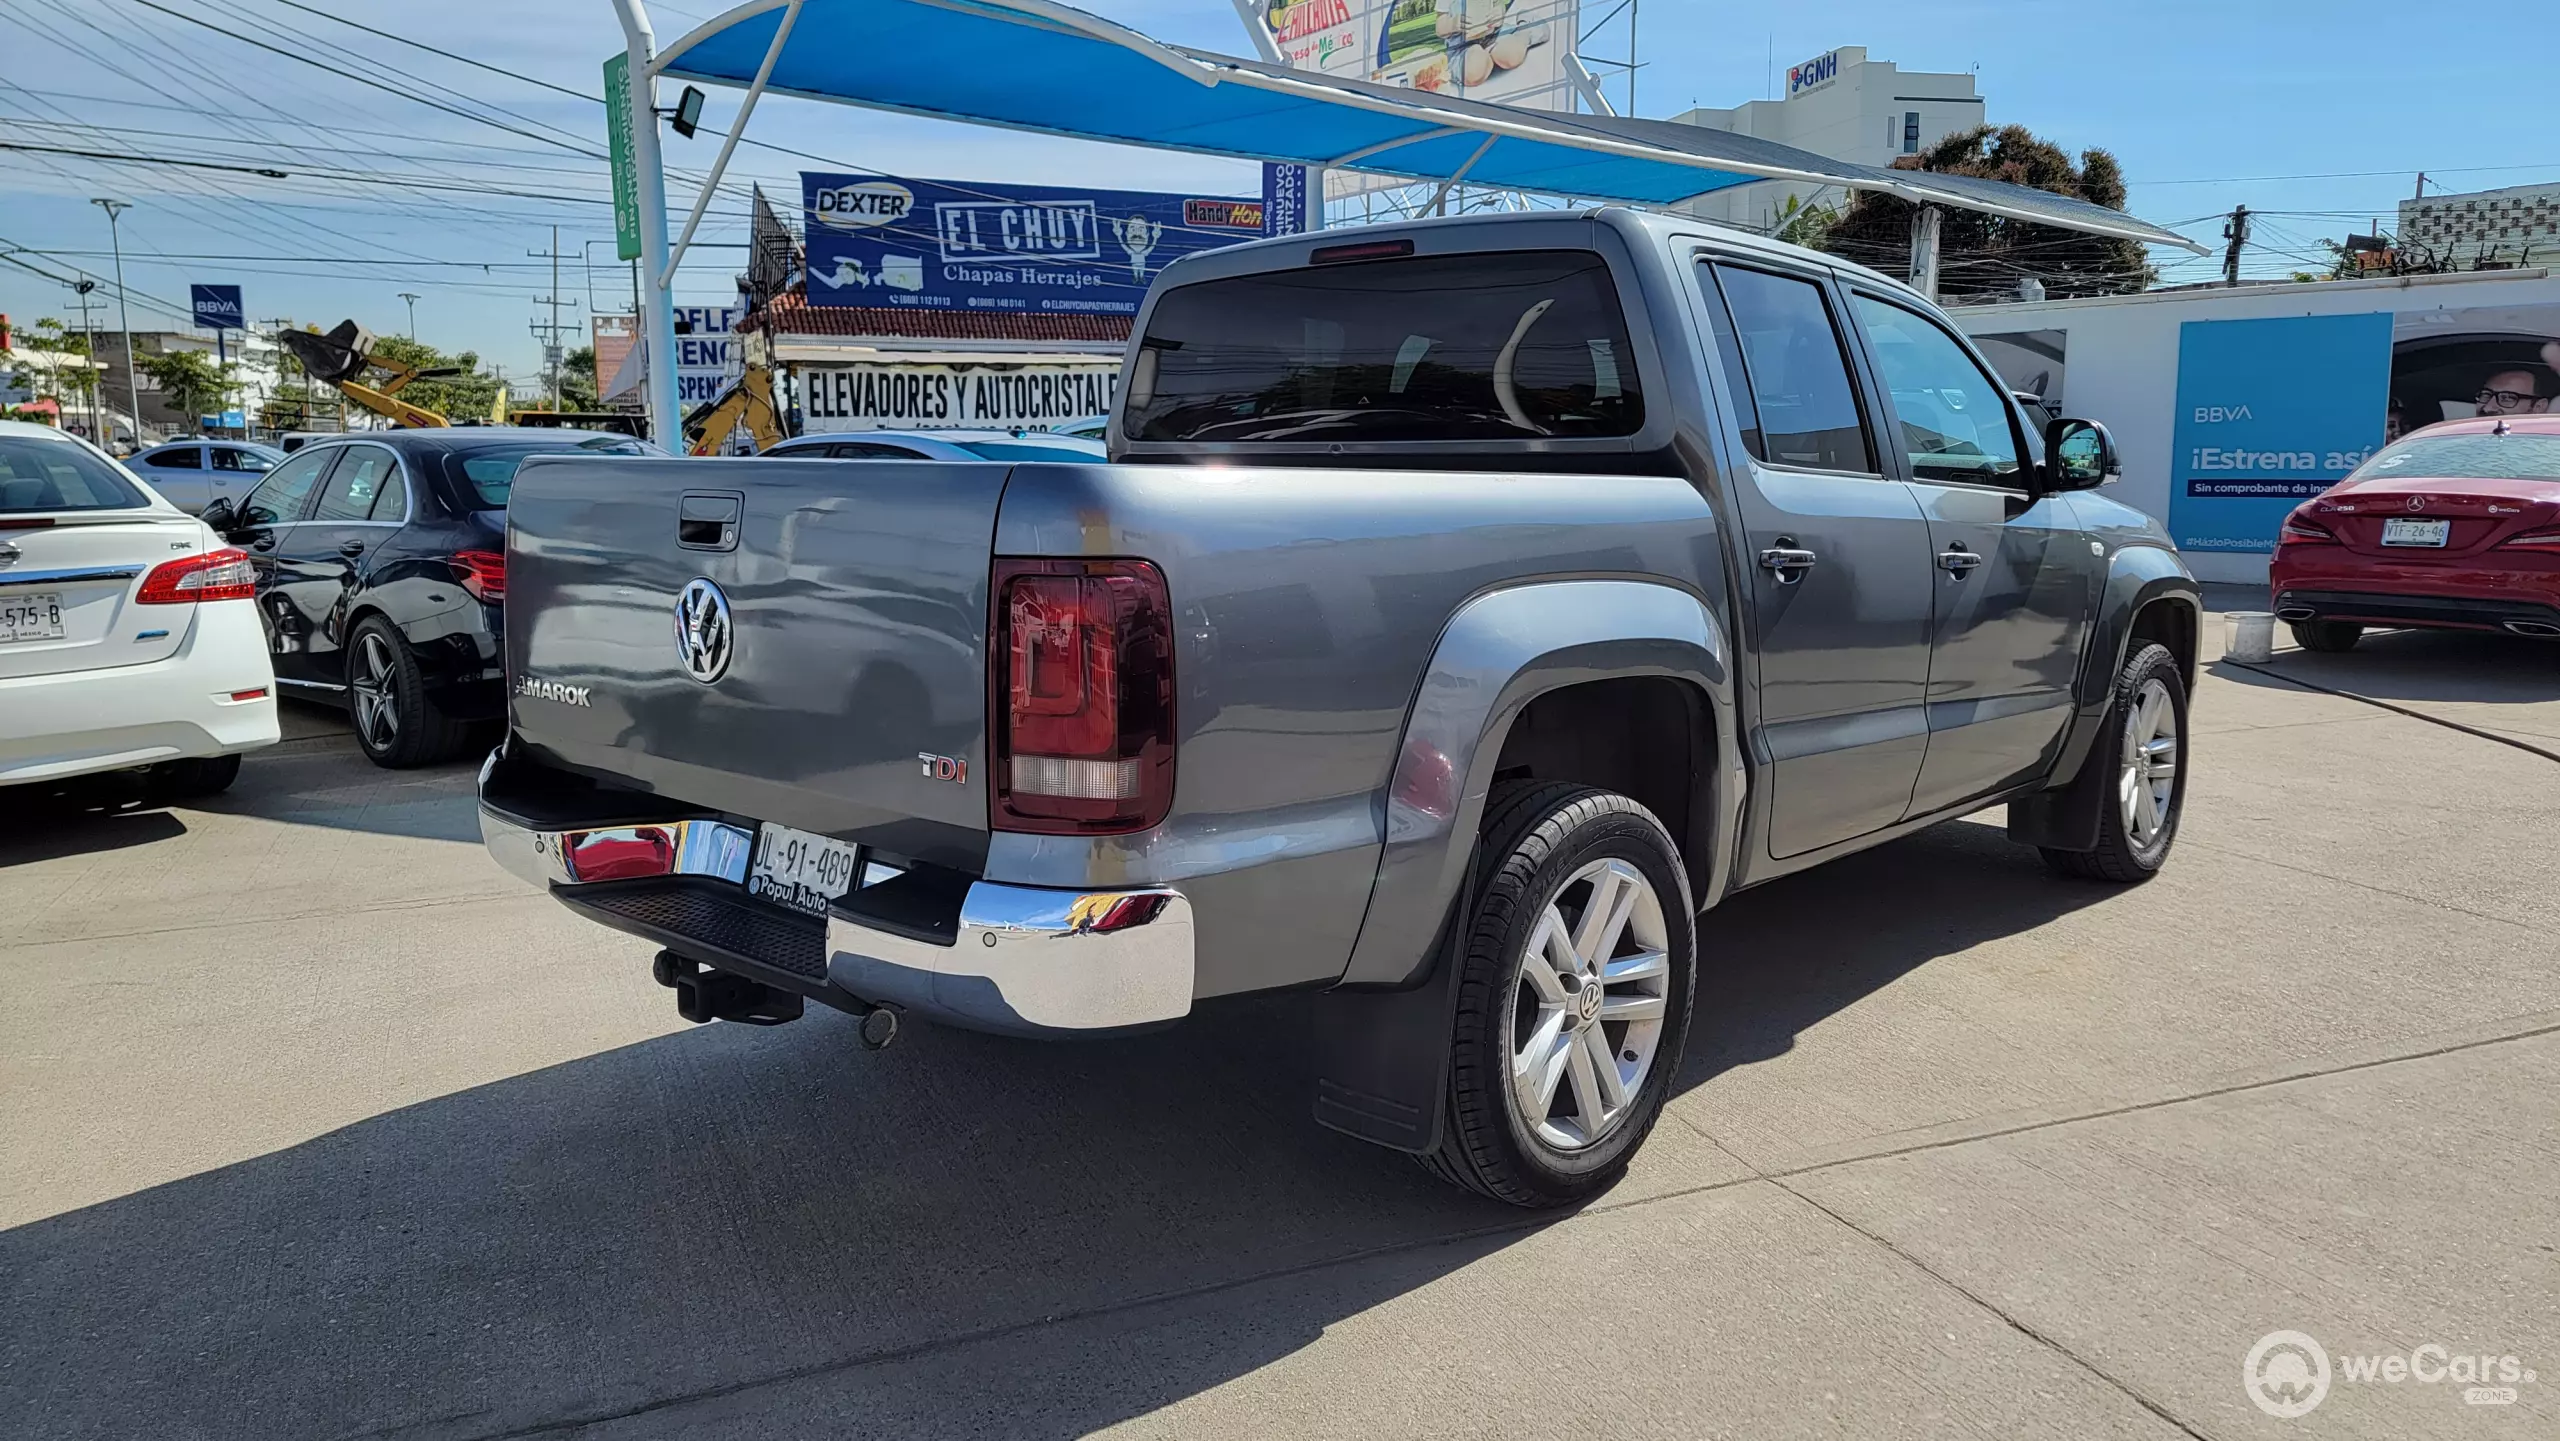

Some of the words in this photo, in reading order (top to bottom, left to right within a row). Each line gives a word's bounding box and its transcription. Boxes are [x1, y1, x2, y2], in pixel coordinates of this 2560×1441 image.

[1803, 52, 1837, 87] GNH
[617, 66, 637, 239] FINANCIAMIENTO
[819, 191, 905, 216] DEXTER
[946, 210, 986, 250] EL
[1001, 208, 1086, 250] CHUY
[943, 264, 1014, 286] Chapas
[1021, 268, 1101, 289] Herrajes
[196, 300, 238, 313] BBVA
[808, 372, 948, 418] ELEVADORES
[954, 375, 967, 419] Y
[2194, 405, 2252, 423] BBVA
[2192, 448, 2316, 470] ¡Estrena
[2195, 483, 2211, 493] Sin
[2214, 484, 2290, 494] comprobante
[2292, 483, 2307, 493] de
[515, 676, 592, 707] AMAROK
[918, 752, 967, 784] TDI
[760, 875, 796, 902] Popul
[796, 886, 827, 911] Auto
